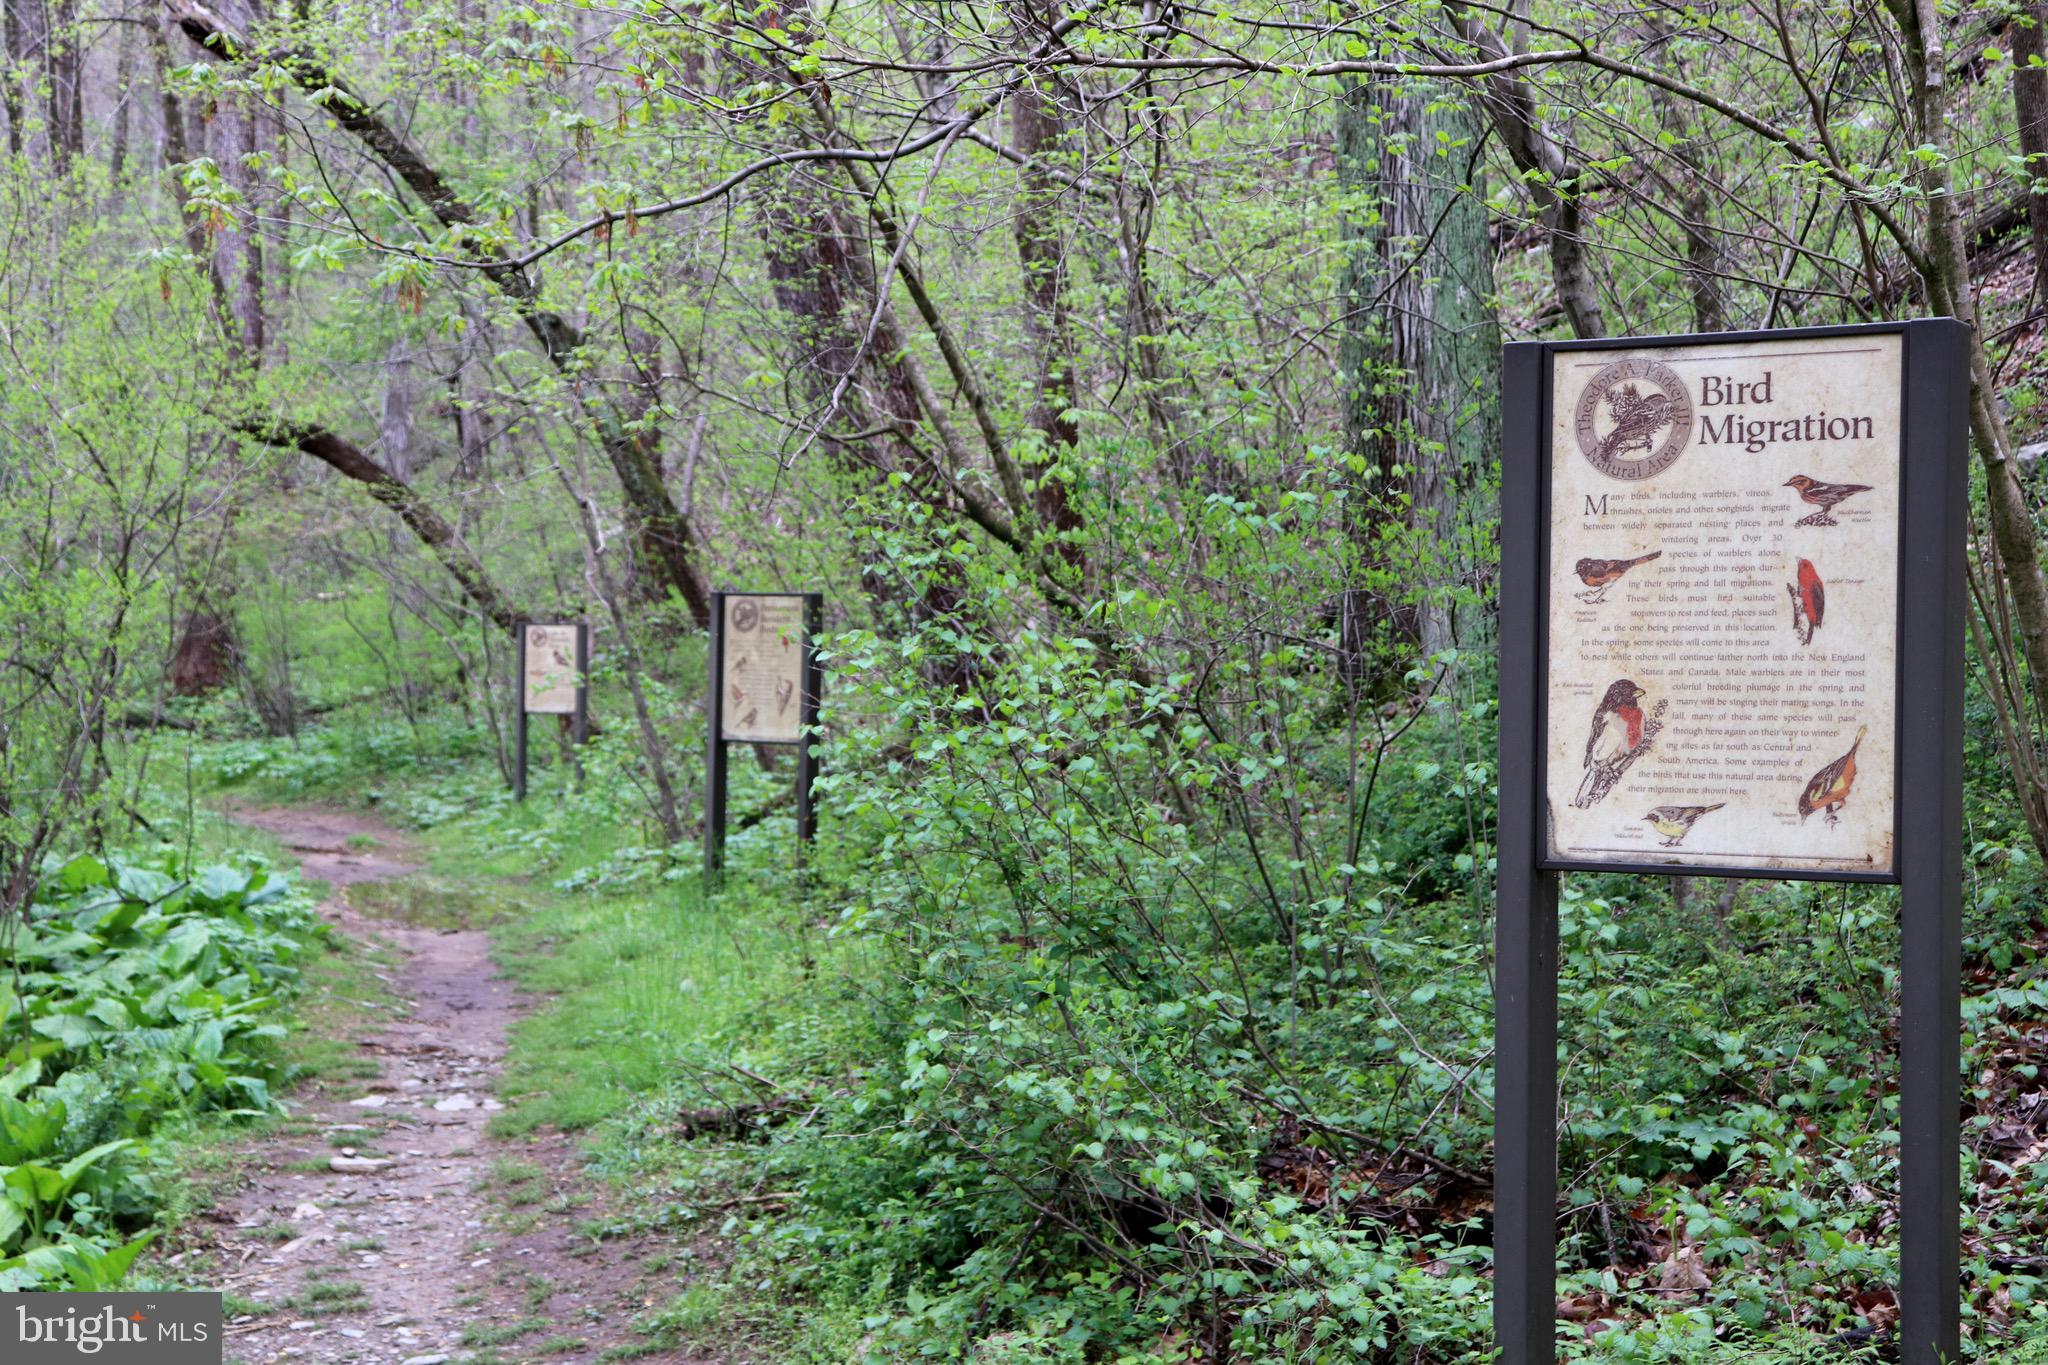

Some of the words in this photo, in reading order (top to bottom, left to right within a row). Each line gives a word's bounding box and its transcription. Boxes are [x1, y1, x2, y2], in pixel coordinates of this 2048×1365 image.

[1700, 372, 1773, 407] Bird
[1578, 368, 1620, 433] Theodore
[1698, 411, 1875, 454] Migration
[1647, 444, 1678, 475] Area
[1659, 489, 1697, 502] including
[1647, 504, 1673, 515] orioles
[1675, 504, 1691, 514] and
[1693, 503, 1714, 513] other
[1716, 502, 1755, 515] songbirds
[1760, 502, 1791, 514] migrate
[1583, 520, 1616, 530] between
[1620, 519, 1648, 532] widely
[1654, 518, 1693, 531] separated
[1699, 518, 1729, 530] nesting
[1735, 517, 1761, 530] places
[1767, 517, 1785, 526] and
[1660, 534, 1699, 546] wintering
[1741, 532, 1762, 542] Over
[1668, 548, 1698, 560] species
[1703, 548, 1712, 557] of
[1717, 547, 1753, 557] warblers
[1757, 547, 1782, 557] alone
[1658, 566, 1677, 575] pass
[1679, 562, 1711, 575] through
[1713, 562, 1728, 572] this
[1731, 562, 1756, 574] region
[1628, 579, 1641, 590] ing
[1644, 578, 1662, 588] their
[1666, 578, 1691, 590] spring
[1694, 577, 1710, 587] and
[1713, 577, 1726, 586] fall
[1625, 592, 1649, 602] These
[1658, 592, 1679, 602] birds
[1687, 593, 1708, 602] must
[1743, 592, 1776, 601] suitable
[1668, 609, 1676, 617] to
[1678, 609, 1692, 617] rest
[1693, 607, 1710, 617] and
[1731, 607, 1756, 619] places
[1758, 607, 1777, 616] such
[1613, 622, 1626, 631] the
[1647, 622, 1669, 634] being
[1671, 622, 1710, 634] preserved
[1713, 622, 1721, 631] in
[1724, 622, 1740, 631] this
[1581, 637, 1590, 646] In
[1591, 637, 1604, 646] the
[1655, 637, 1684, 649] species
[1685, 637, 1700, 646] will
[1724, 638, 1733, 646] to
[1734, 636, 1751, 646] this
[1580, 653, 1589, 661] to
[1591, 653, 1608, 661] nest
[1610, 651, 1632, 661] while
[1634, 651, 1659, 661] others
[1661, 651, 1676, 661] will
[1679, 652, 1714, 661] continue
[1747, 652, 1768, 661] north
[1772, 652, 1788, 661] into
[1791, 652, 1805, 661] the
[1808, 652, 1828, 661] New
[1831, 652, 1866, 664] England
[1640, 667, 1664, 676] States
[1668, 666, 1684, 676] and
[1725, 666, 1746, 676] Male
[1750, 666, 1785, 676] warblers
[1807, 667, 1816, 676] in
[1820, 666, 1840, 676] their
[1844, 668, 1865, 676] most
[1671, 681, 1702, 691] colorful
[1706, 681, 1742, 693] breeding
[1746, 681, 1781, 694] plumage
[1785, 682, 1794, 691] in
[1799, 682, 1813, 691] the
[1817, 682, 1844, 694] spring
[1848, 682, 1865, 692] and
[1676, 698, 1698, 707] many
[1700, 696, 1715, 705] will
[1717, 696, 1727, 705] be
[1728, 696, 1758, 708] singing
[1759, 696, 1779, 706] their
[1780, 697, 1809, 709] mating
[1839, 698, 1849, 707] In
[1851, 697, 1865, 707] the
[1691, 713, 1714, 723] many
[1717, 711, 1727, 720] of
[1731, 711, 1753, 720] these
[1783, 712, 1813, 723] species
[1817, 712, 1833, 721] will
[1837, 715, 1857, 724] pass
[1672, 725, 1704, 738] through
[1705, 726, 1723, 735] here
[1724, 726, 1747, 738] again
[1760, 726, 1780, 736] their
[1781, 730, 1800, 739] way
[1800, 728, 1810, 737] to
[1666, 741, 1679, 752] ing
[1680, 741, 1699, 750] sites
[1712, 741, 1724, 750] far
[1726, 741, 1749, 751] south
[1763, 741, 1794, 751] Central
[1796, 742, 1812, 751] and
[1657, 755, 1681, 765] South
[1724, 756, 1748, 765] Some
[1751, 756, 1790, 768] examples
[1794, 756, 1804, 766] of
[1638, 768, 1651, 778] the
[1652, 769, 1673, 779] birds
[1674, 769, 1690, 779] that
[1708, 770, 1723, 780] this
[1725, 770, 1754, 781] natural
[1776, 772, 1803, 784] during
[1627, 783, 1647, 793] their
[1648, 784, 1685, 796] migration
[1700, 785, 1727, 795] shown
